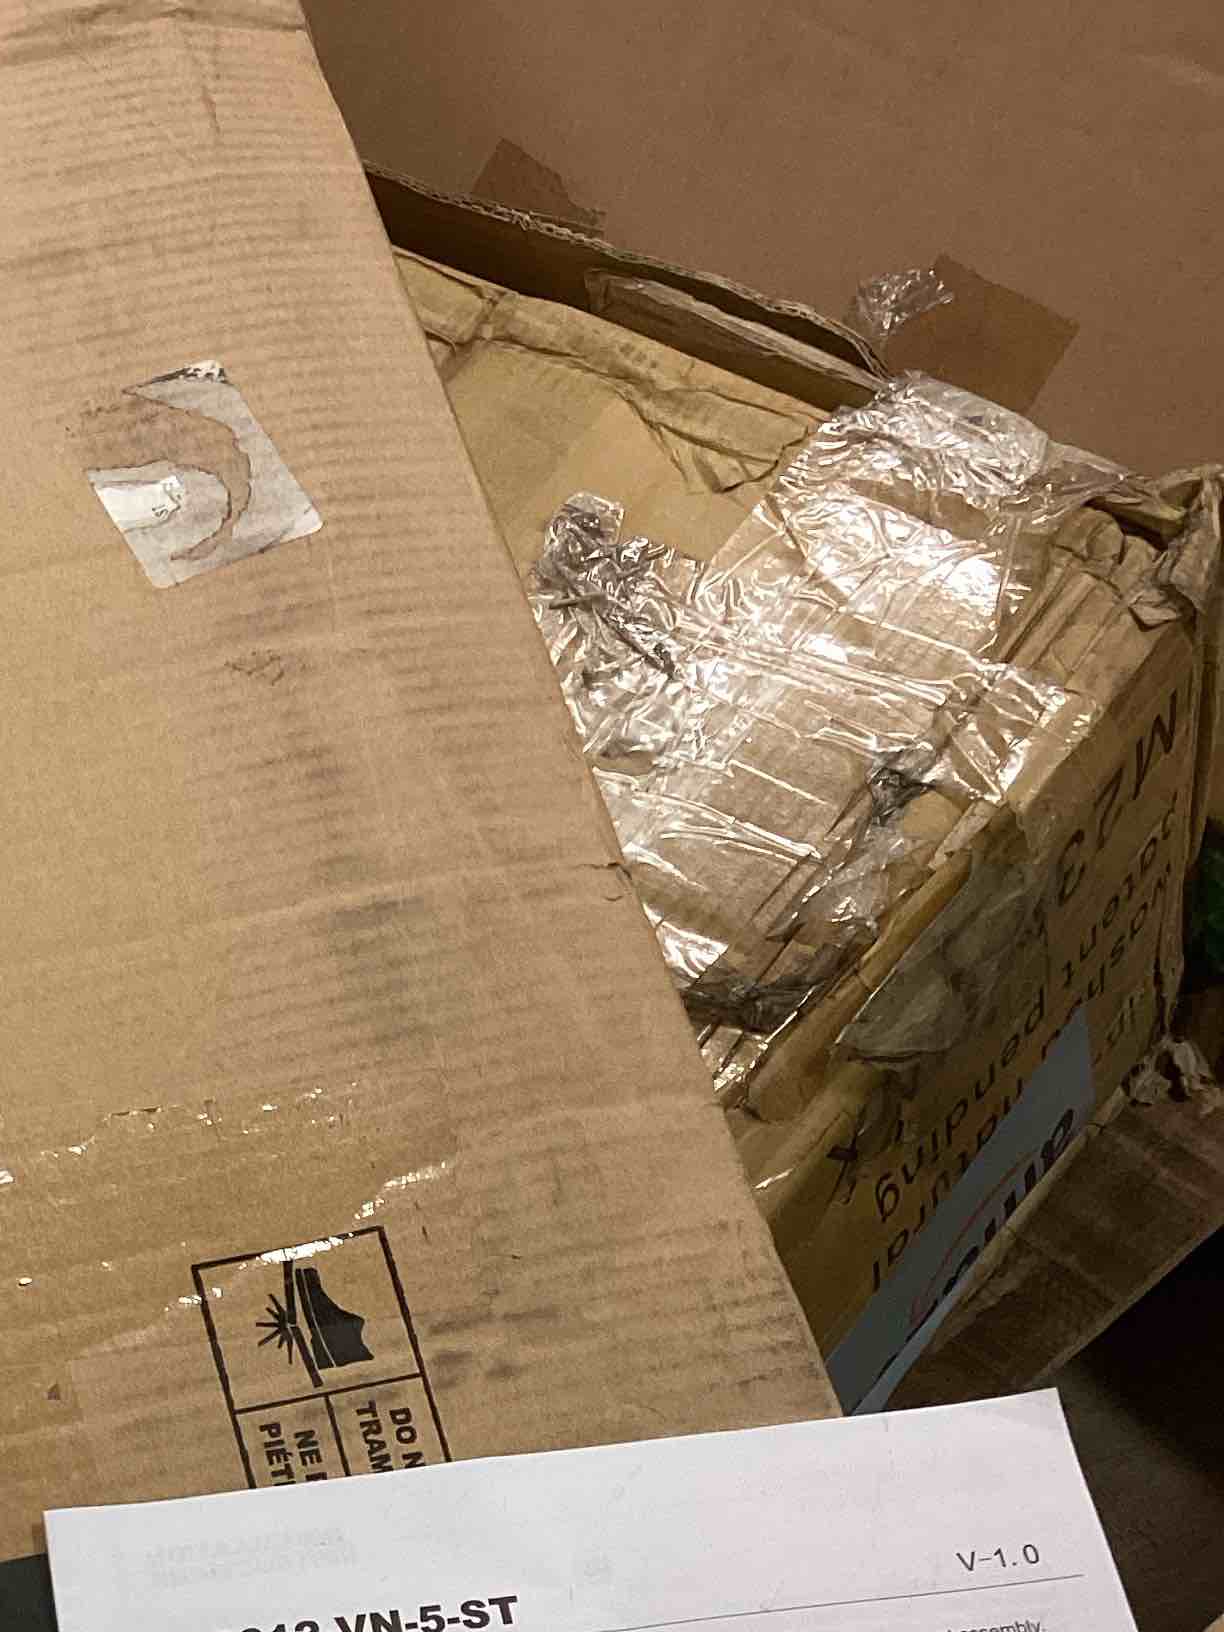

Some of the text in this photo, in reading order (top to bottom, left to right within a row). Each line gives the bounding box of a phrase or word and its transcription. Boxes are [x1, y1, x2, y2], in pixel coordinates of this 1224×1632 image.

[876, 983, 1048, 1223] pending
[389, 1407, 418, 1444] DO
[294, 1429, 324, 1466] NE
